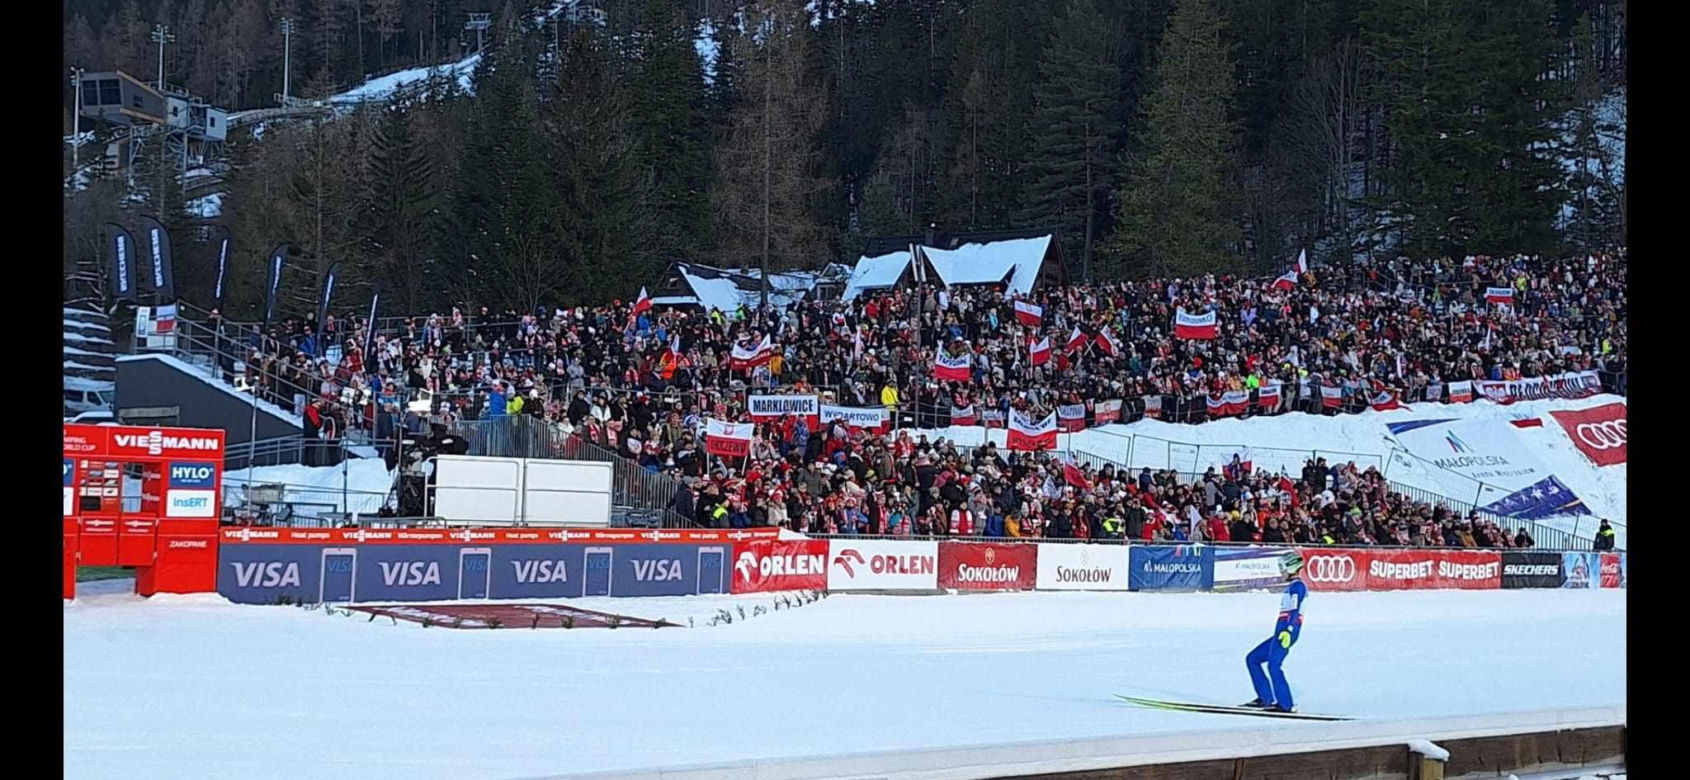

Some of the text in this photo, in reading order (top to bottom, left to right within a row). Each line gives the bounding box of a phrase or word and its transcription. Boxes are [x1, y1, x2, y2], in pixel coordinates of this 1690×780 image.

[114, 431, 218, 455] VIESSMANN
[172, 467, 210, 479] HYLO
[224, 528, 279, 541] VIESSMANN
[343, 529, 392, 542] VIESSMANN
[229, 561, 300, 587] VISA
[377, 561, 441, 586] VISA
[510, 560, 568, 583] VISA
[630, 559, 682, 581] VISA
[760, 554, 824, 576] ORLEN
[870, 554, 934, 575] ORLEN
[1369, 559, 1434, 579] SUPERBET
[1438, 560, 1499, 580] SUPERBET
[1503, 564, 1559, 575] SKECHERS
